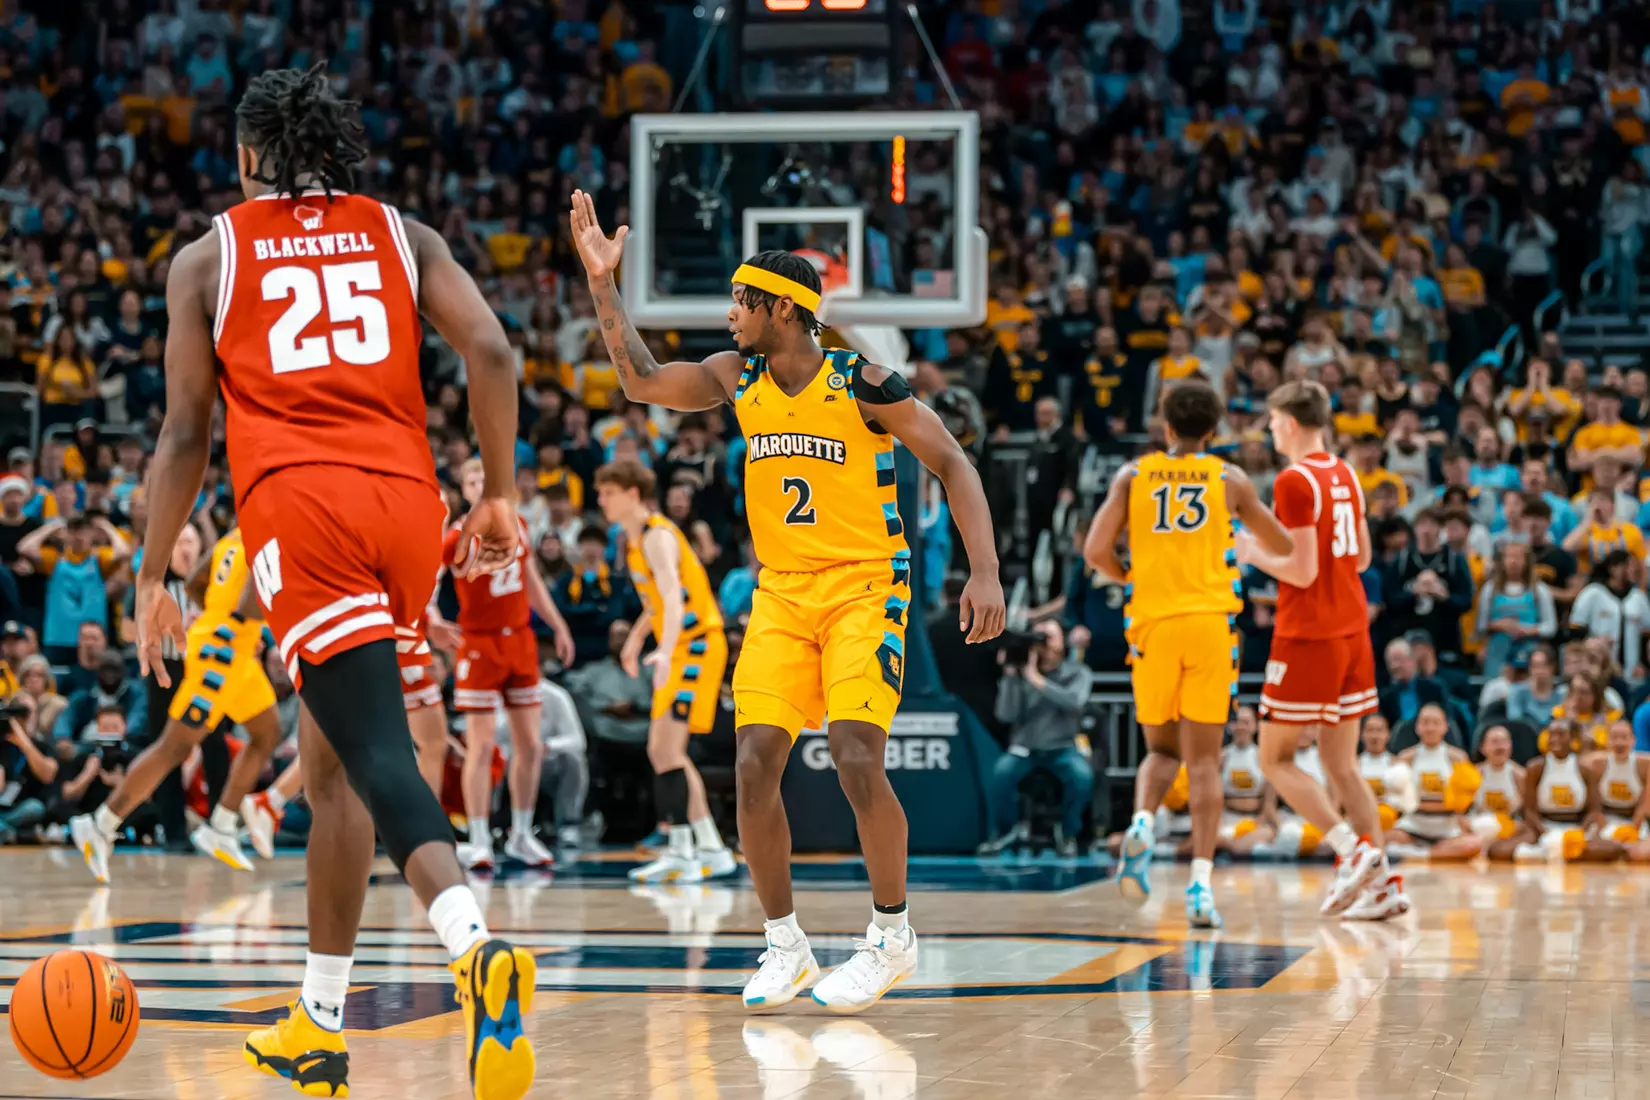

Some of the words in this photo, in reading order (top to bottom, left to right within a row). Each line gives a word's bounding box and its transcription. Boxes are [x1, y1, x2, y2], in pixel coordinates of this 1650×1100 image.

[253, 232, 376, 261] BLACKWELL
[261, 260, 391, 375] 25
[749, 433, 847, 466] MARQUETTE
[781, 476, 817, 526] 2
[1150, 482, 1210, 533] 13
[1331, 501, 1360, 558] 31
[802, 738, 951, 771] GBER
